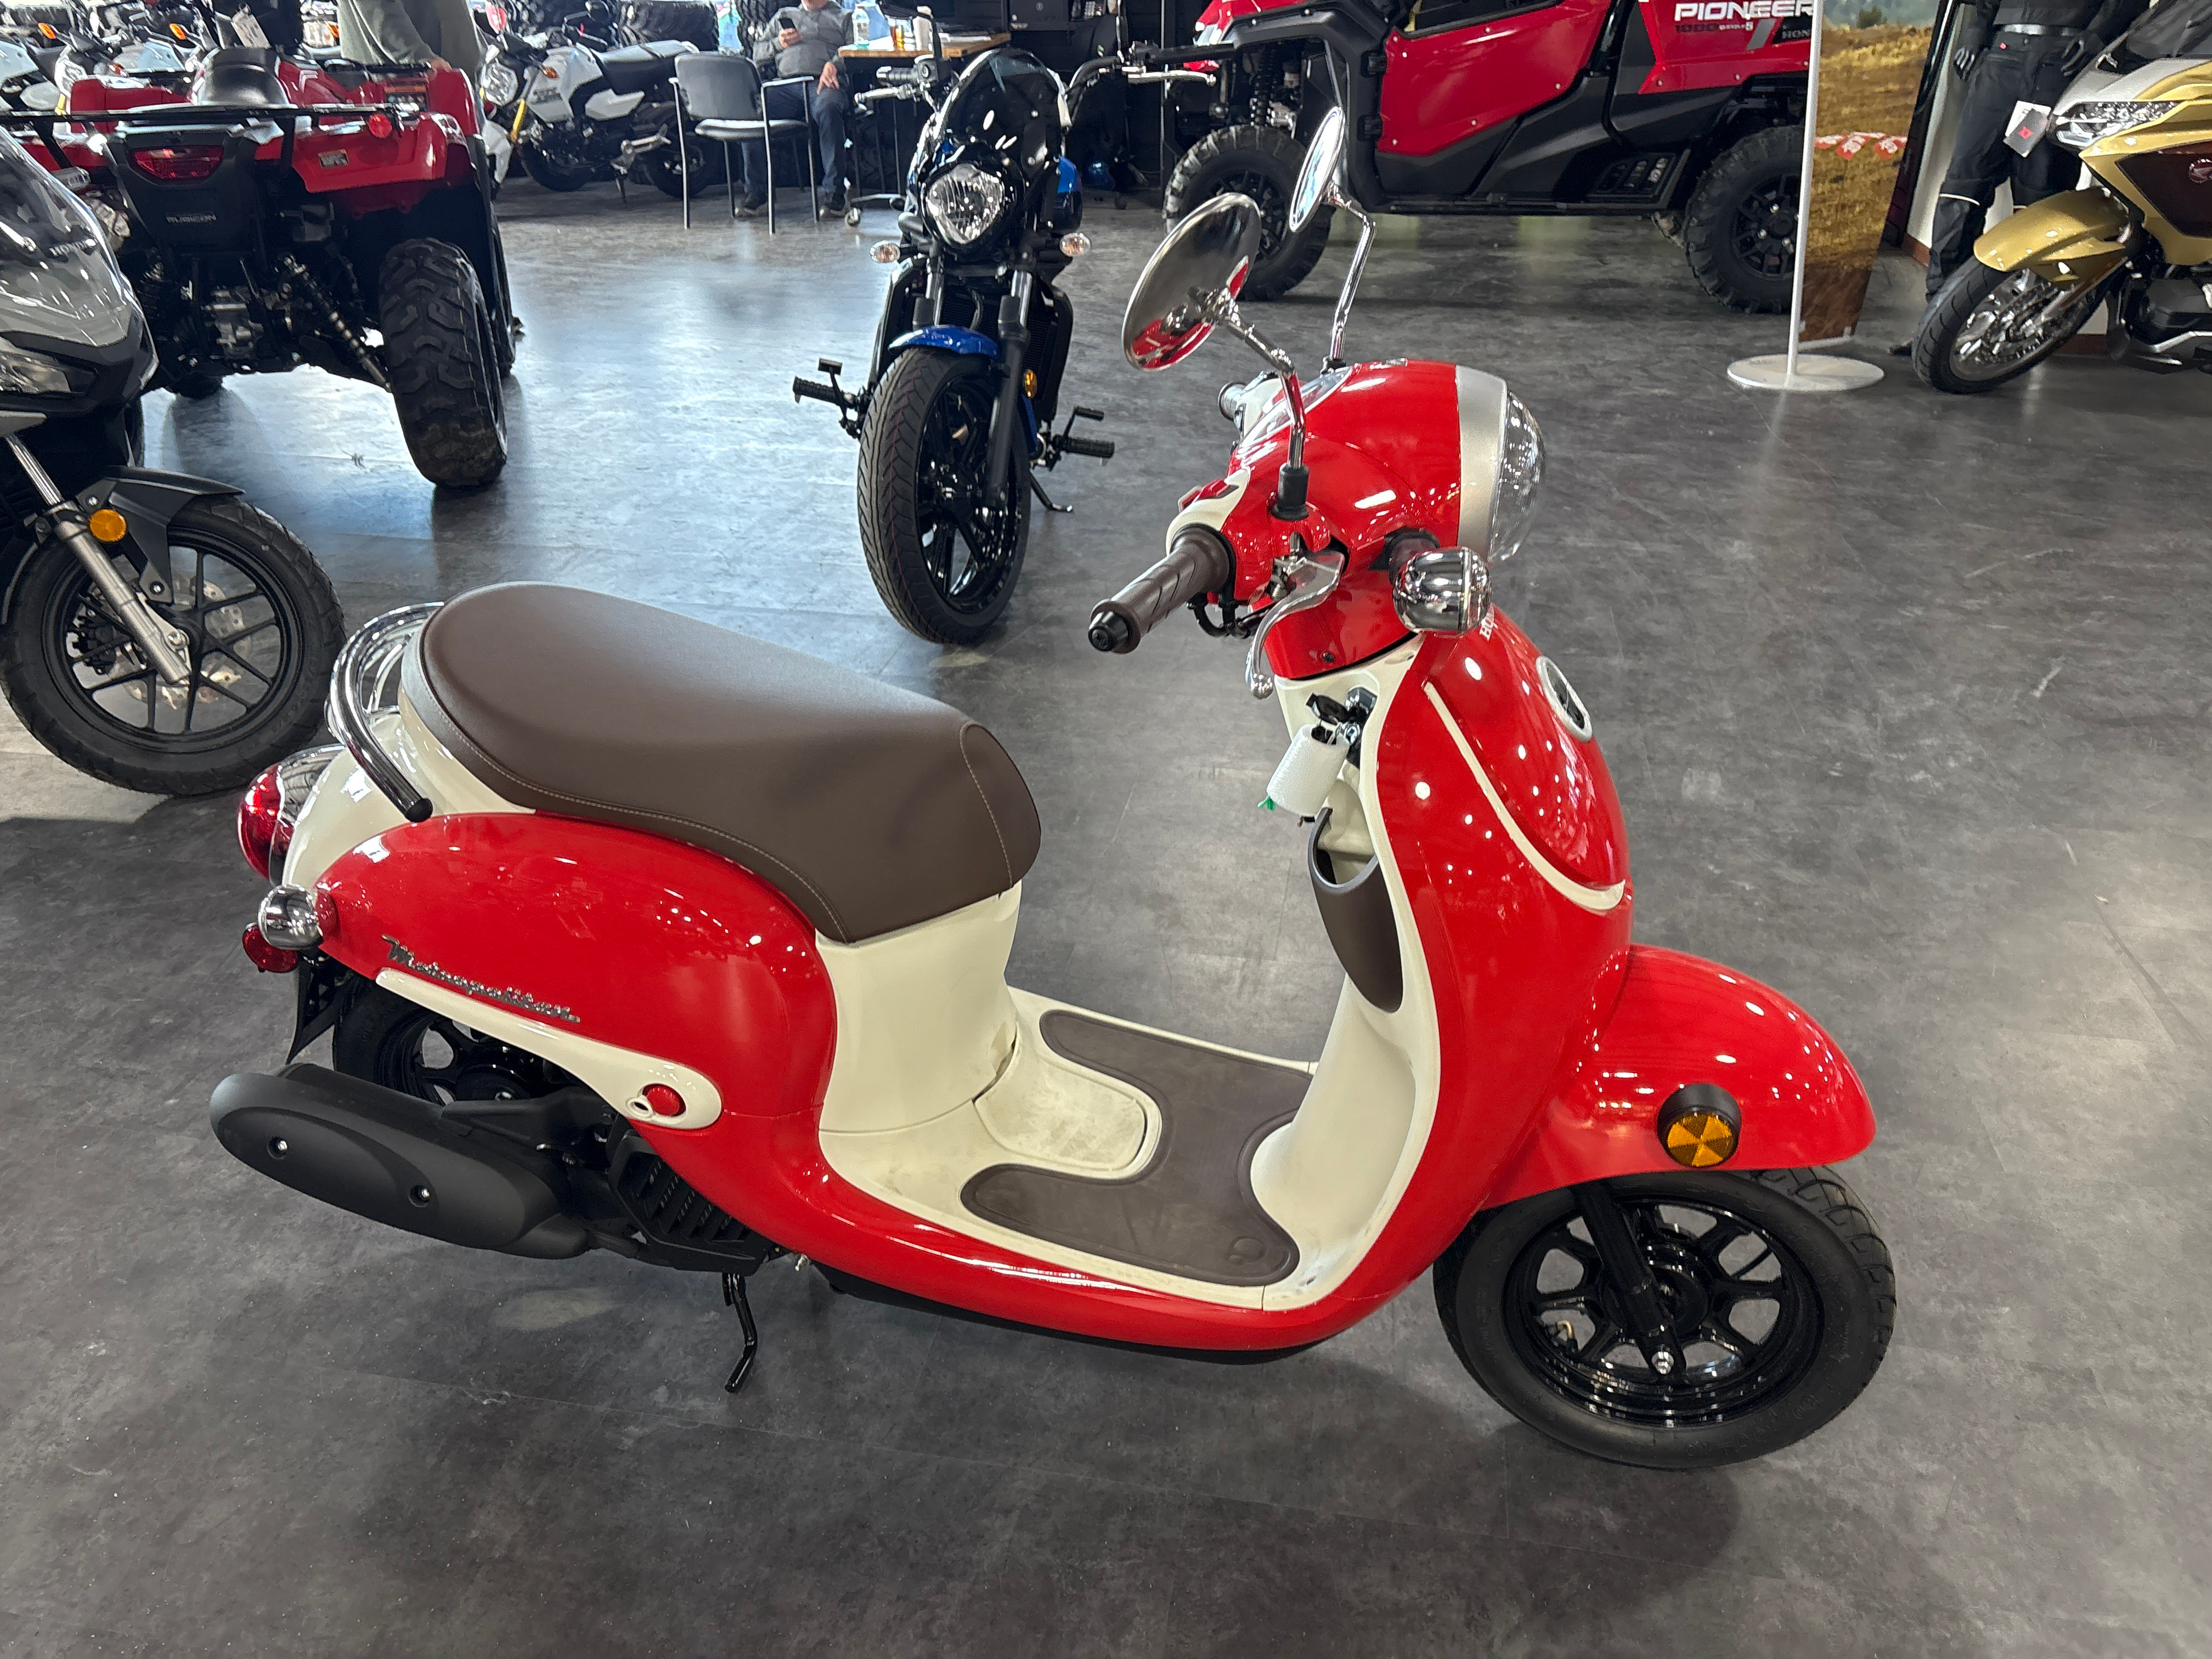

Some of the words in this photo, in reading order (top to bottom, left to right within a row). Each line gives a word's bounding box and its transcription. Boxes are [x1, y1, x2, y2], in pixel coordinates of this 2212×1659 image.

[1674, 1, 1813, 21] PIONEER
[1781, 29, 1811, 39] HON
[166, 215, 217, 223] RUBICON
